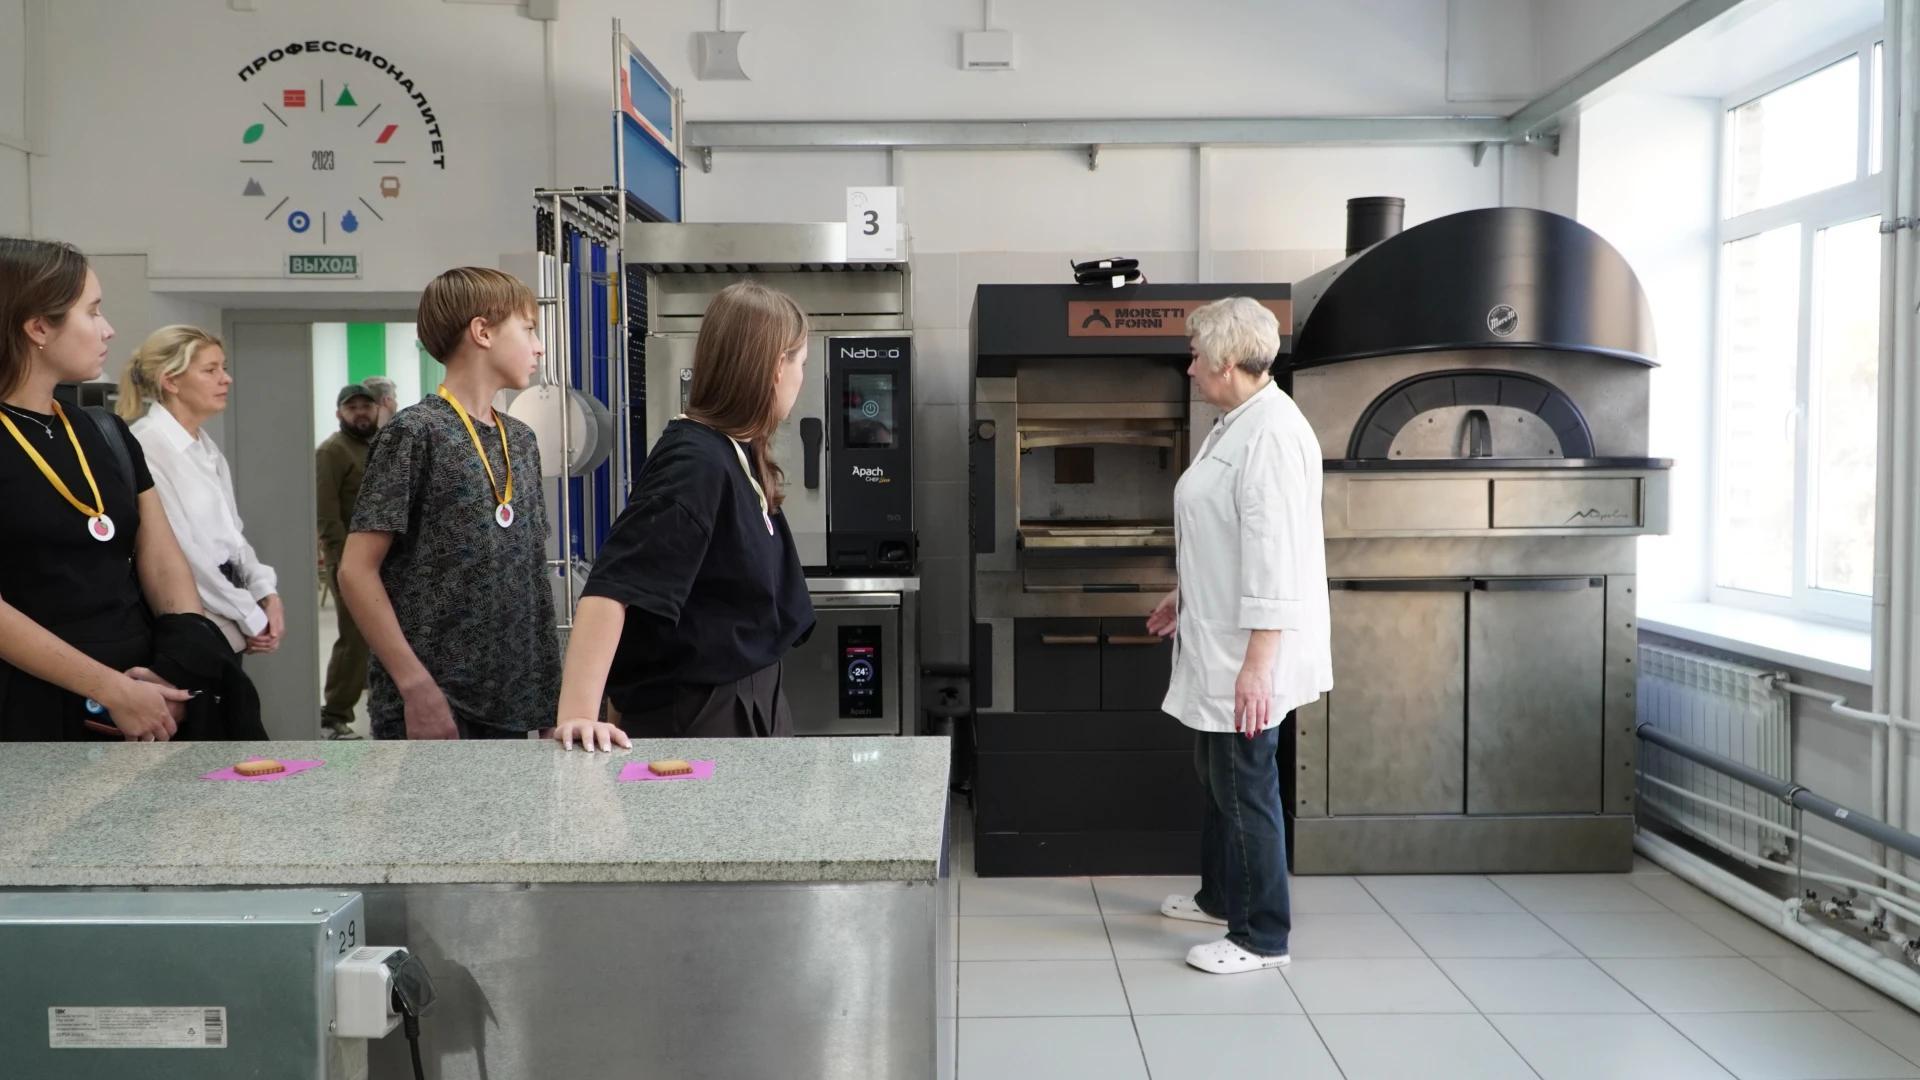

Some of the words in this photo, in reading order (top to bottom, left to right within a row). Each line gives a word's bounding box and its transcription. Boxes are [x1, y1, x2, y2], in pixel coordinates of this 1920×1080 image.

[238, 41, 445, 169] ПРОФЕССИОНАЛИТЕТ
[312, 150, 334, 170] 2023
[863, 210, 880, 236] 3
[292, 257, 354, 273] ВЫХОД
[1115, 308, 1185, 318] MORETTI
[1115, 319, 1163, 329] FORNI
[840, 347, 900, 359] Naboo
[852, 465, 884, 478] Apach
[339, 920, 355, 954] 29
